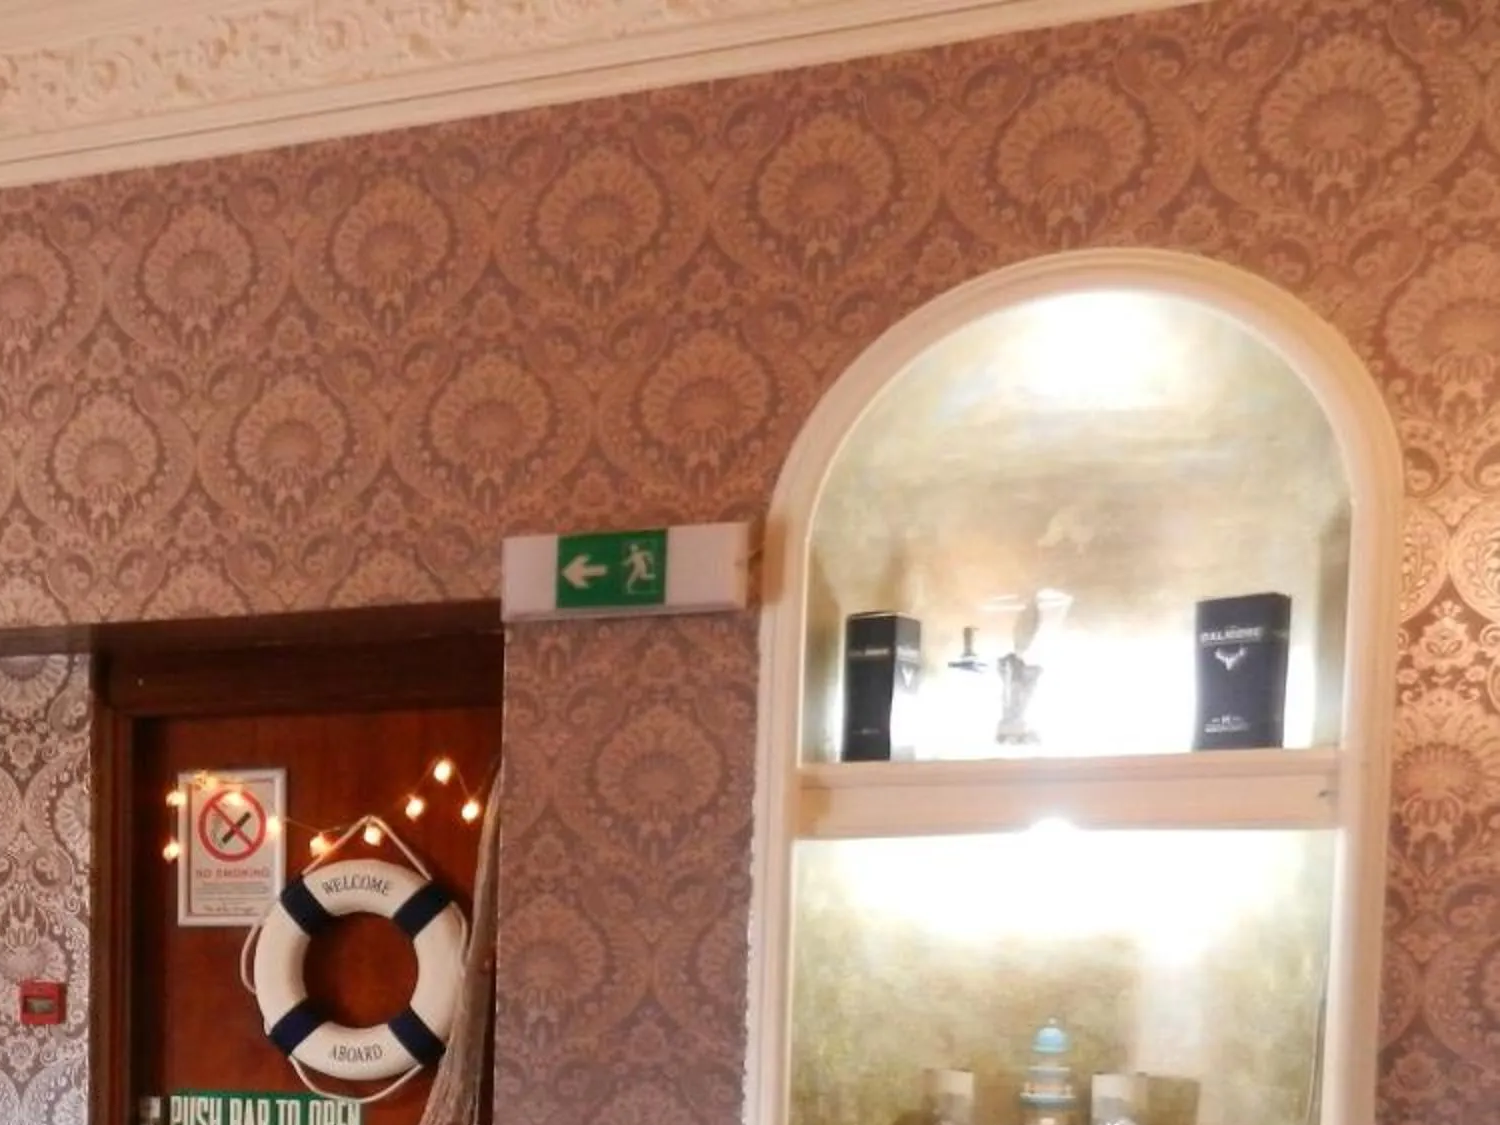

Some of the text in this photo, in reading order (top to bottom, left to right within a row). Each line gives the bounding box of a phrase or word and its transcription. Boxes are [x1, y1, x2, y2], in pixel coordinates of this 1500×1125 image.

[195, 866, 271, 879] NO SMOKING
[322, 873, 390, 896] WELCOME
[328, 1042, 383, 1063] ABOARD
